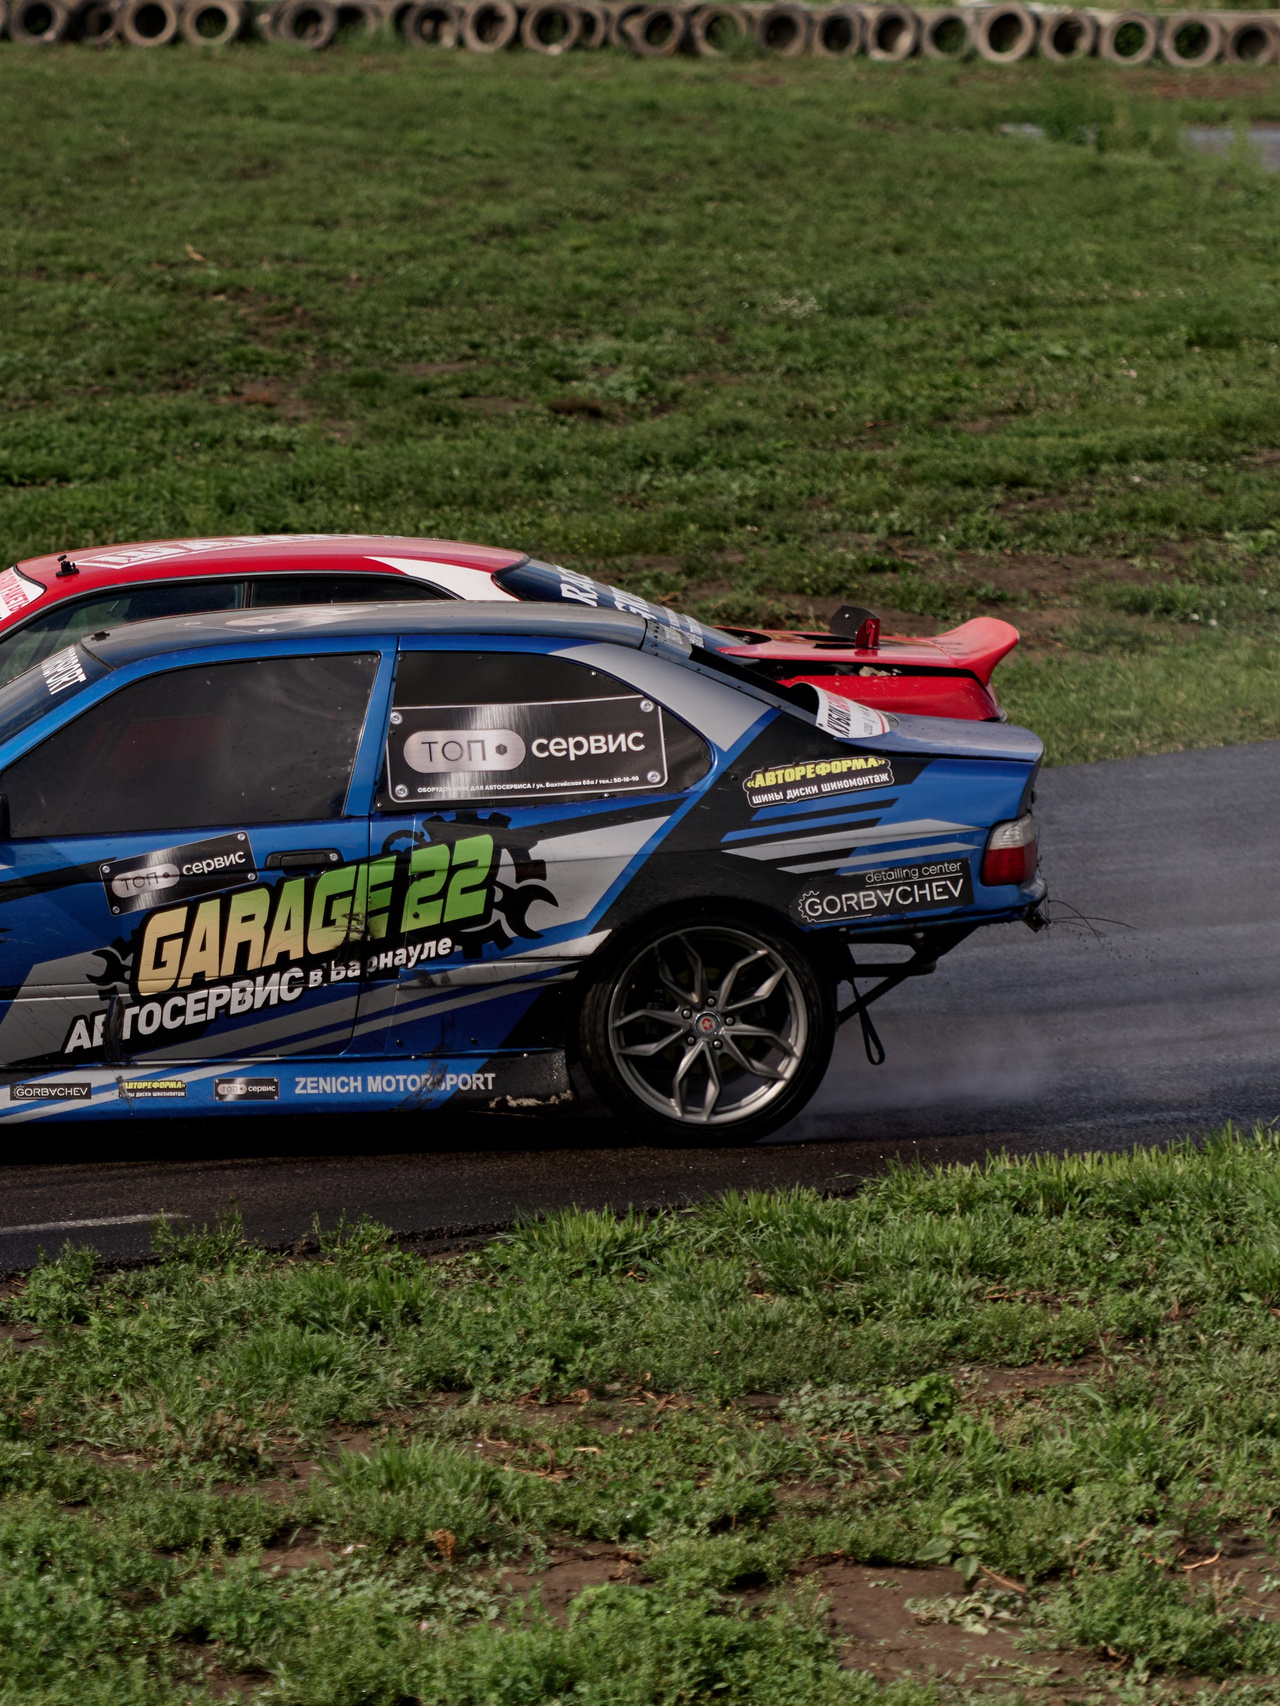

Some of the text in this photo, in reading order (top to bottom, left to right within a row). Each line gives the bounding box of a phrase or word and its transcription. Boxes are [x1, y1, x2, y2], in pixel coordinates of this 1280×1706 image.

[421, 731, 646, 762] ТОП сервис
[747, 757, 886, 788] «АВТОРЕФОРМА»
[121, 851, 246, 891] ТОП сервис
[865, 862, 962, 883] detailing center
[804, 879, 964, 917] GORBACHEV
[137, 834, 494, 997] GARAGE 22
[15, 1086, 88, 1097] GORBACHEV
[123, 1080, 186, 1090] АВТОРЕФОРМА»
[248, 1084, 276, 1094] сервис
[295, 1076, 362, 1094] ZENICH
